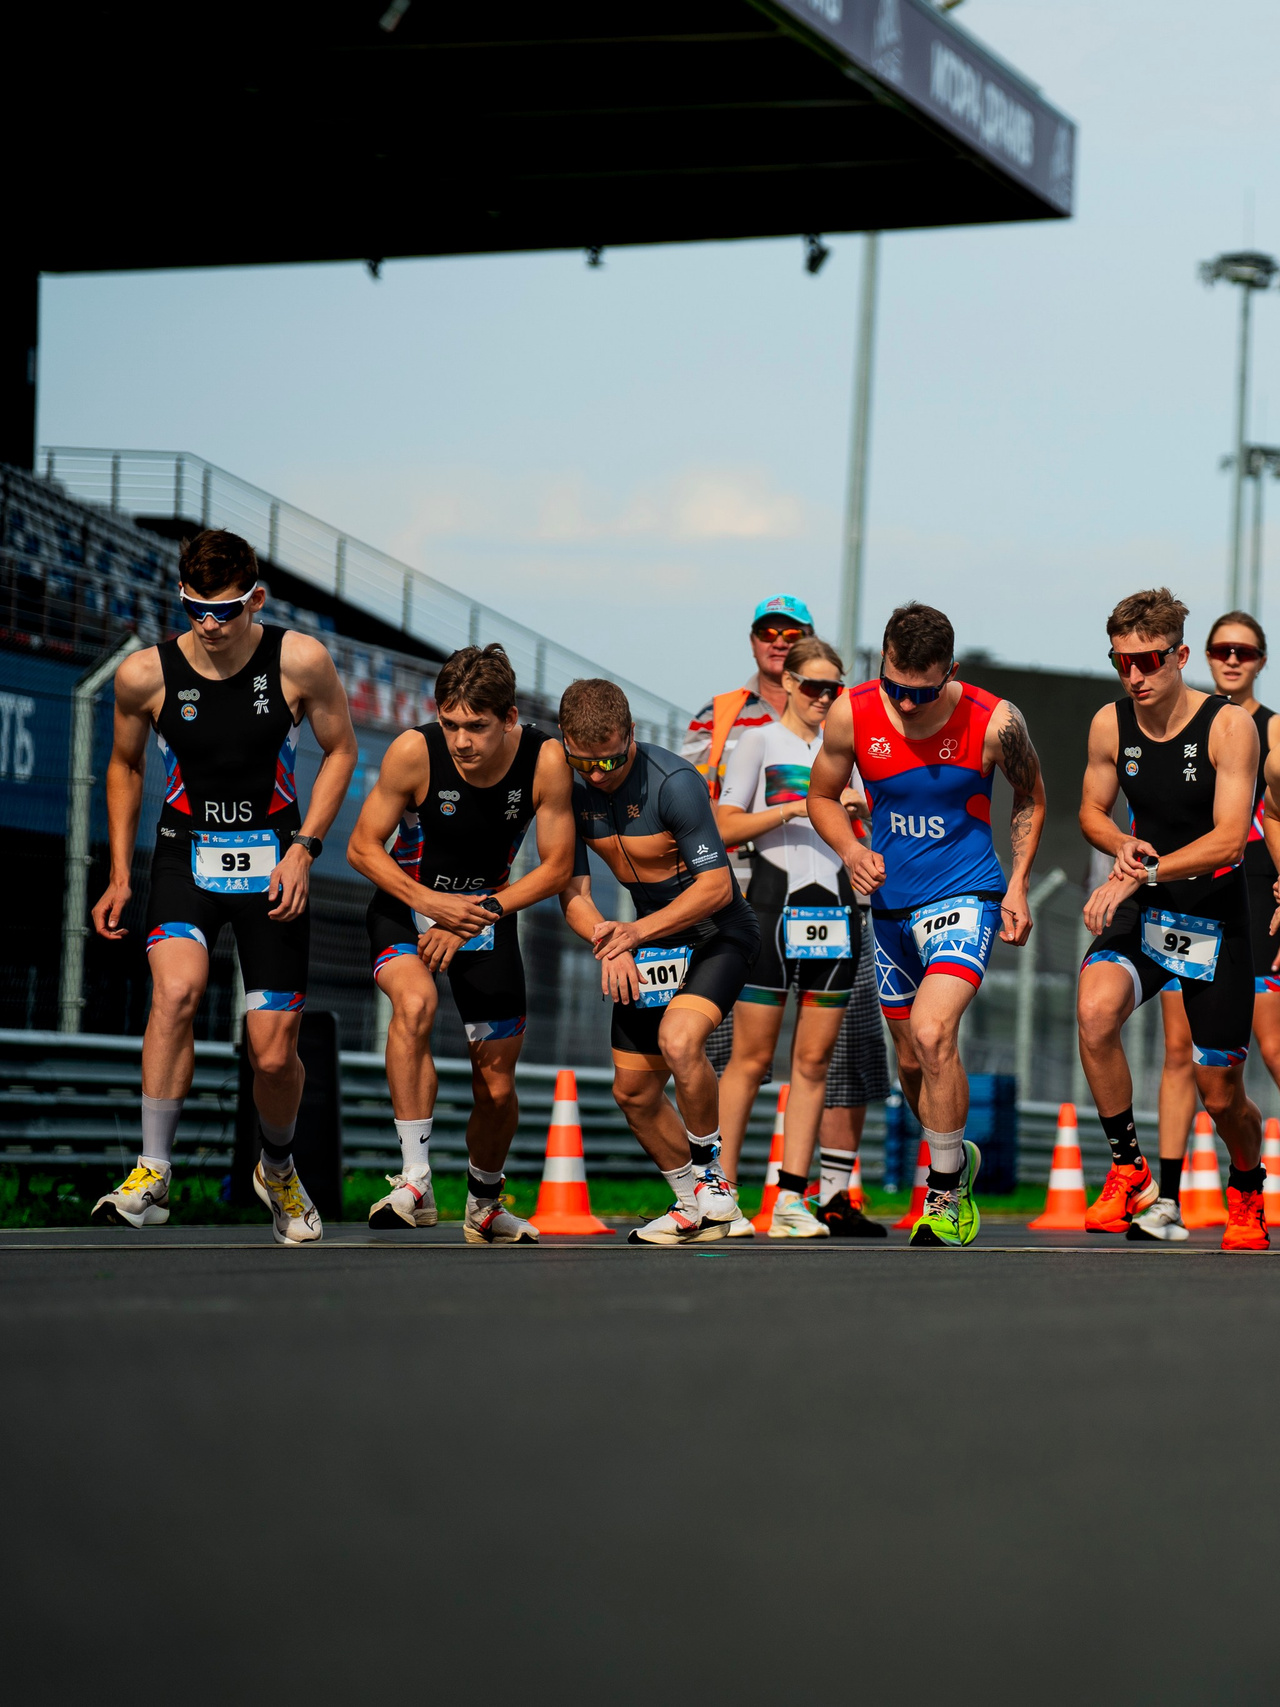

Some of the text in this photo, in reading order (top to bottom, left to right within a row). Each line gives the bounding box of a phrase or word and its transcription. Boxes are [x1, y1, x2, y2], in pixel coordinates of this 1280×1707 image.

[204, 800, 253, 824] RUS
[890, 811, 946, 839] RUS
[221, 852, 251, 872] 93
[433, 874, 485, 890] RUS
[806, 925, 828, 941] 90
[923, 911, 960, 935] 100
[1163, 932, 1192, 955] 92
[646, 964, 678, 986] 101
